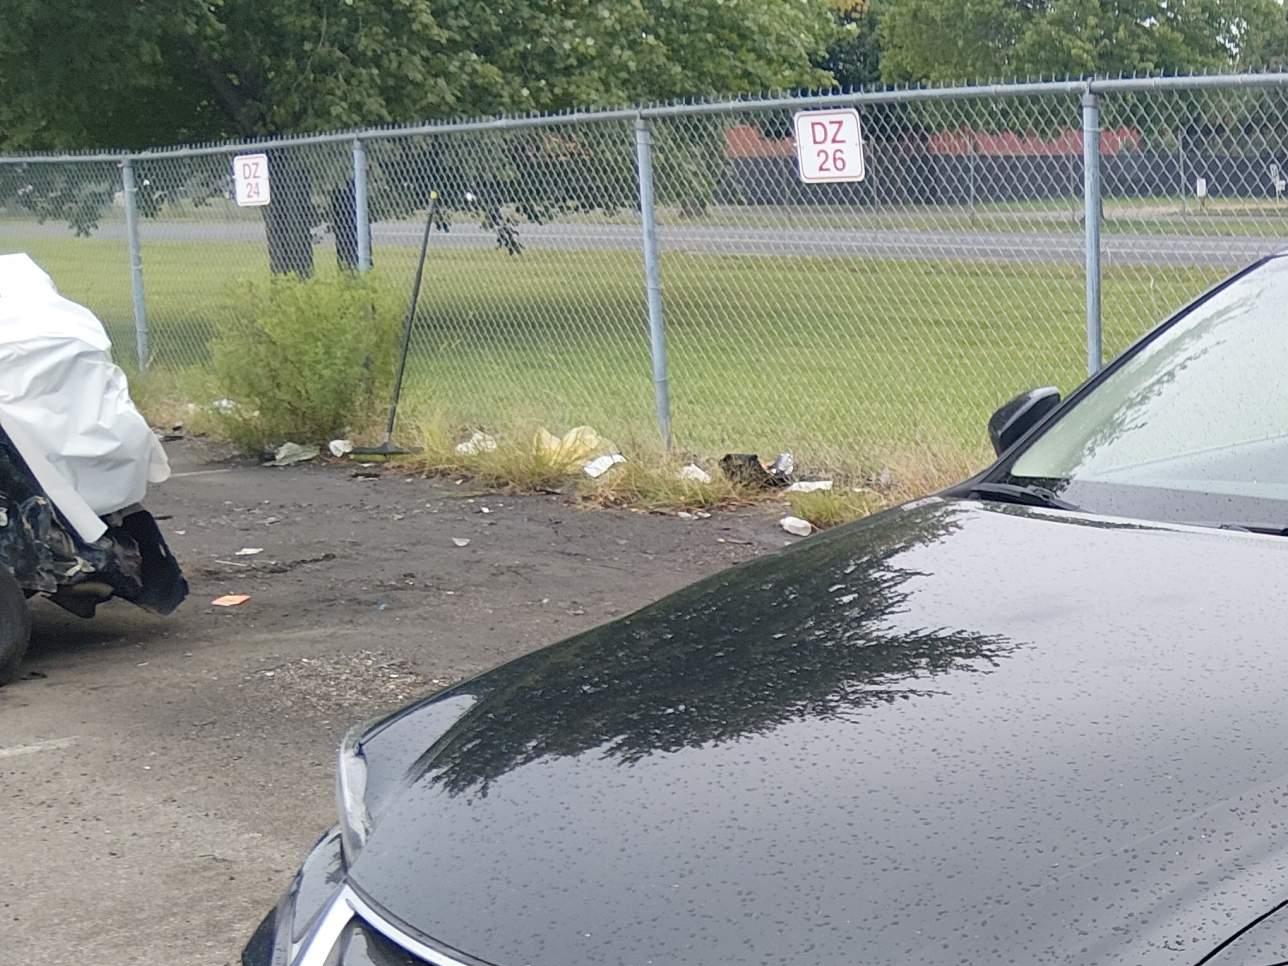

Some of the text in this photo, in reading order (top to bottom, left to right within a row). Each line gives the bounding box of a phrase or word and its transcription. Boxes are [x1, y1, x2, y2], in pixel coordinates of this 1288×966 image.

[811, 120, 846, 145] DZ
[242, 161, 261, 180] DZ
[817, 148, 846, 172] 26
[246, 182, 260, 198] 24
